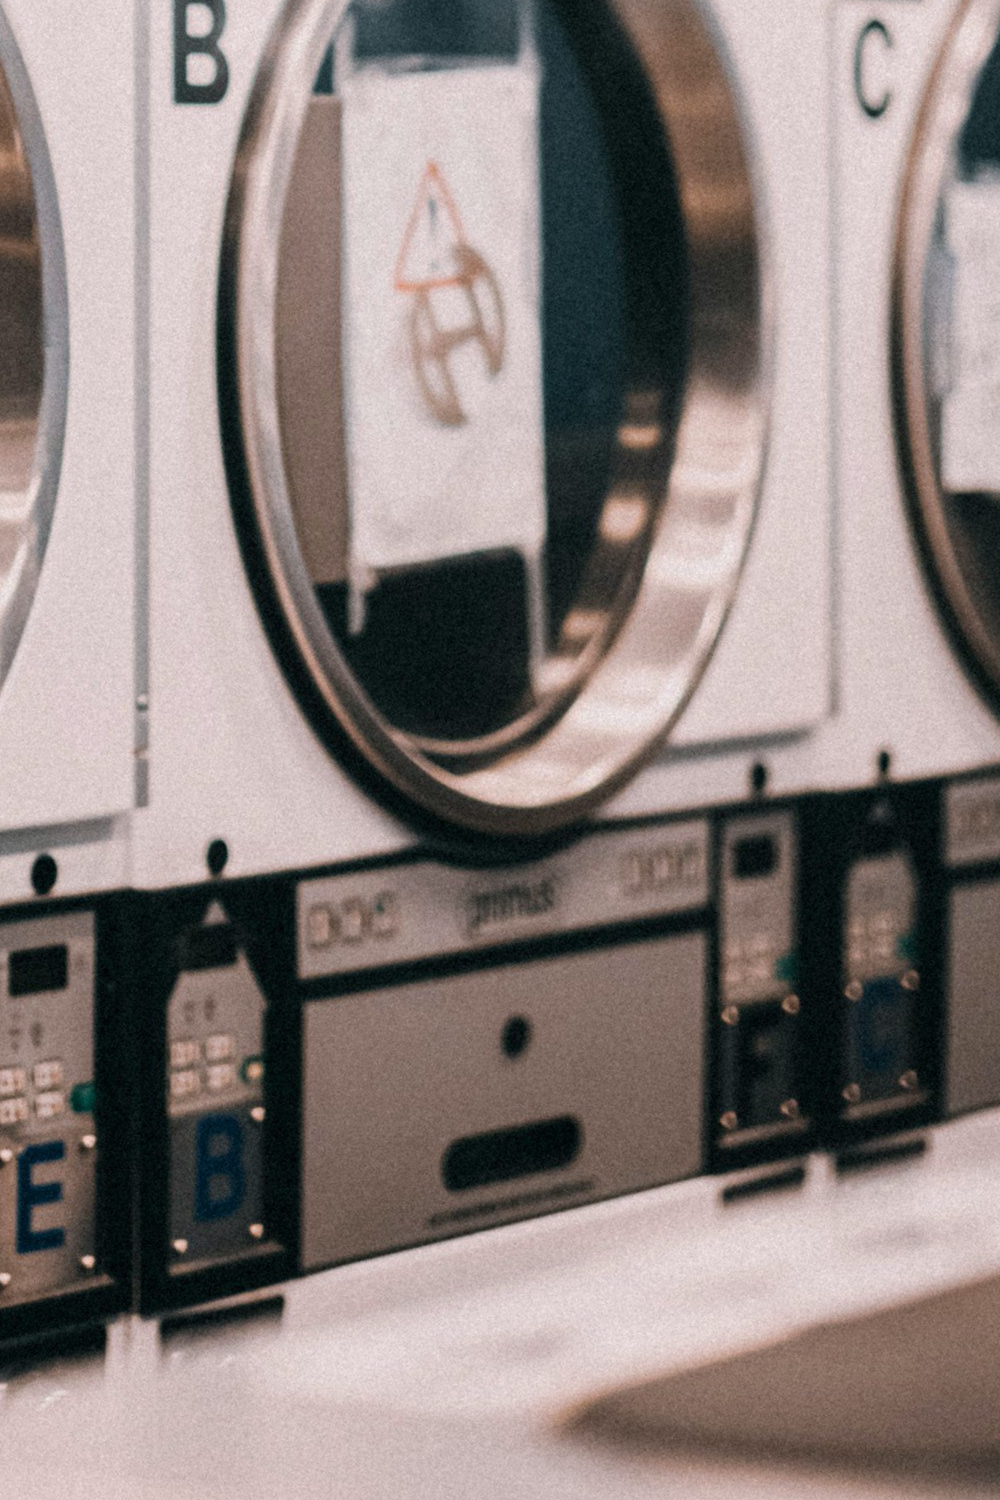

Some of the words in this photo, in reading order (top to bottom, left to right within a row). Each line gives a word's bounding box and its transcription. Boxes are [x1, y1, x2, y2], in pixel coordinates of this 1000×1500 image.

[854, 19, 893, 119] C
[16, 1140, 65, 1254] E
[195, 1114, 246, 1222] B
